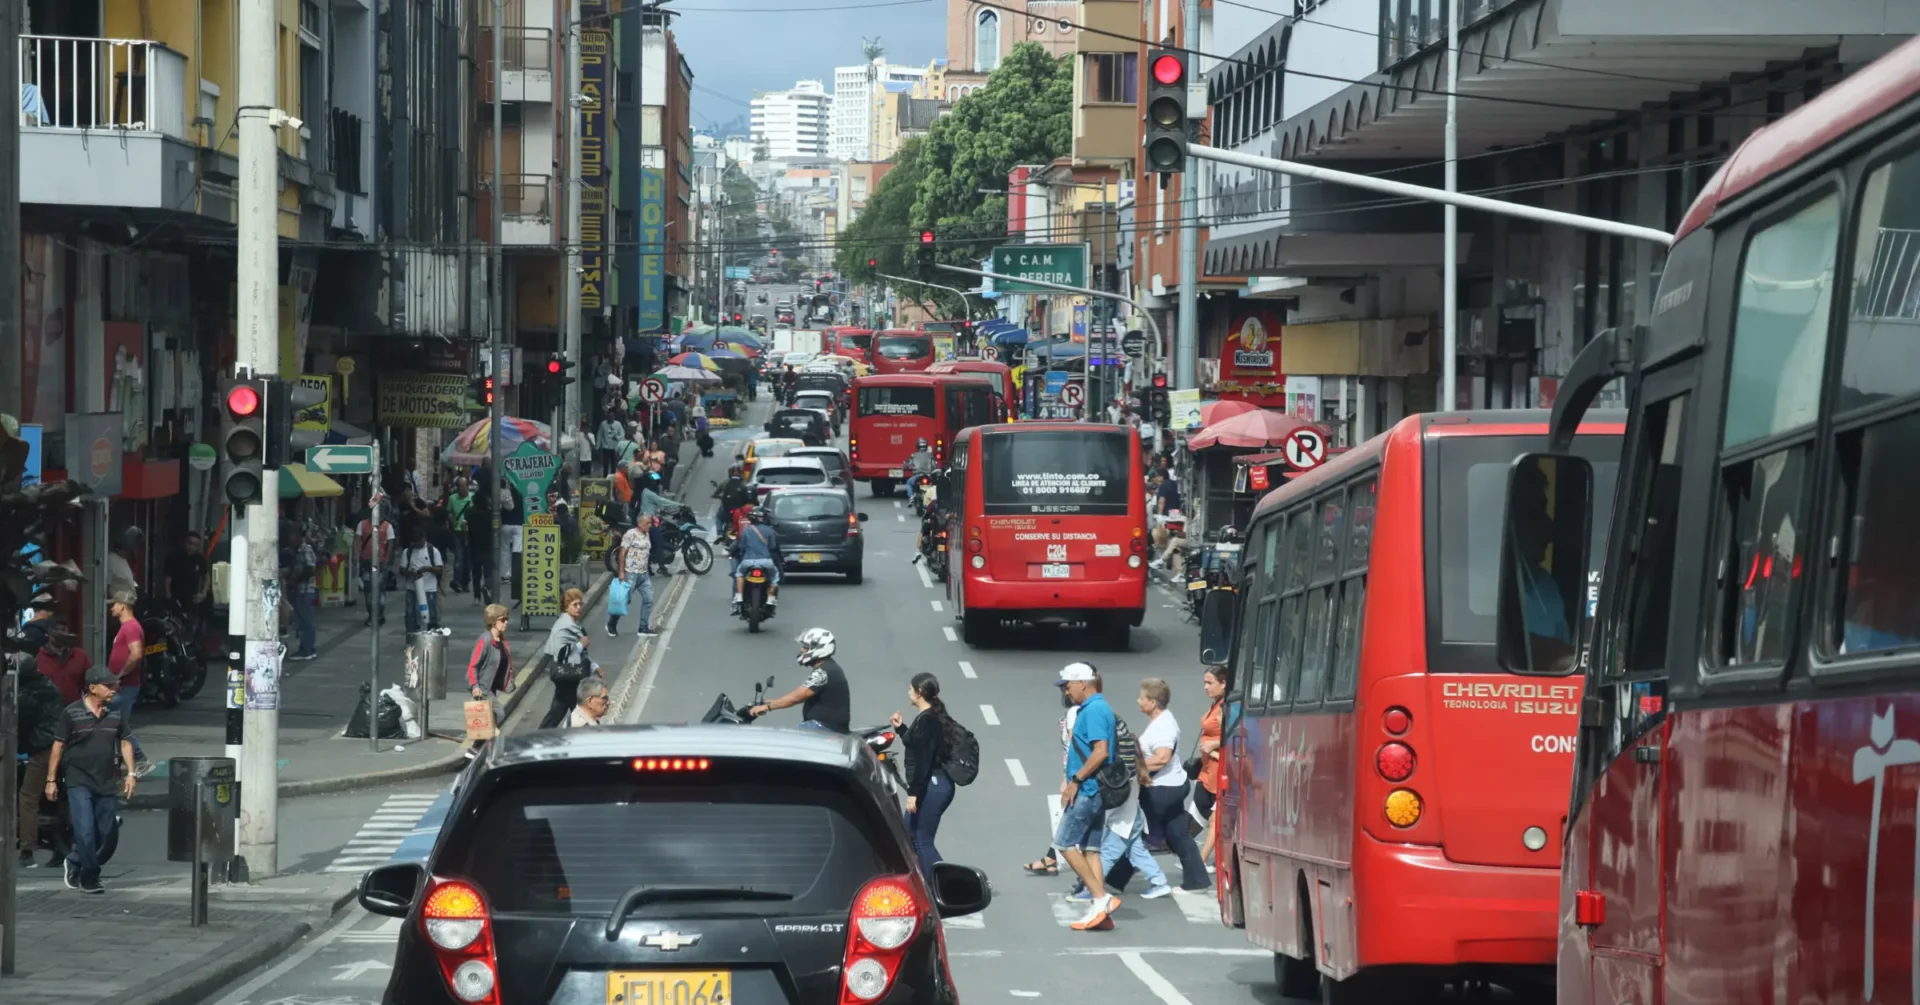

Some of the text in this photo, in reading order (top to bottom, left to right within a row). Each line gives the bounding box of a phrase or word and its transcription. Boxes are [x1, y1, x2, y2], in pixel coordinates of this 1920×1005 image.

[643, 178, 661, 301] HOTEL
[382, 383, 464, 396] PARQUEADERO
[382, 396, 437, 414] DE MOTOS
[504, 455, 555, 471] CERAJERIA
[526, 528, 540, 611] PARQUEADERO
[544, 533, 556, 592] MOTOS
[1443, 683, 1579, 699] CHEVROLET
[1443, 699, 1578, 715] TECNOLOGIA ISUZU
[821, 924, 844, 933] GT
